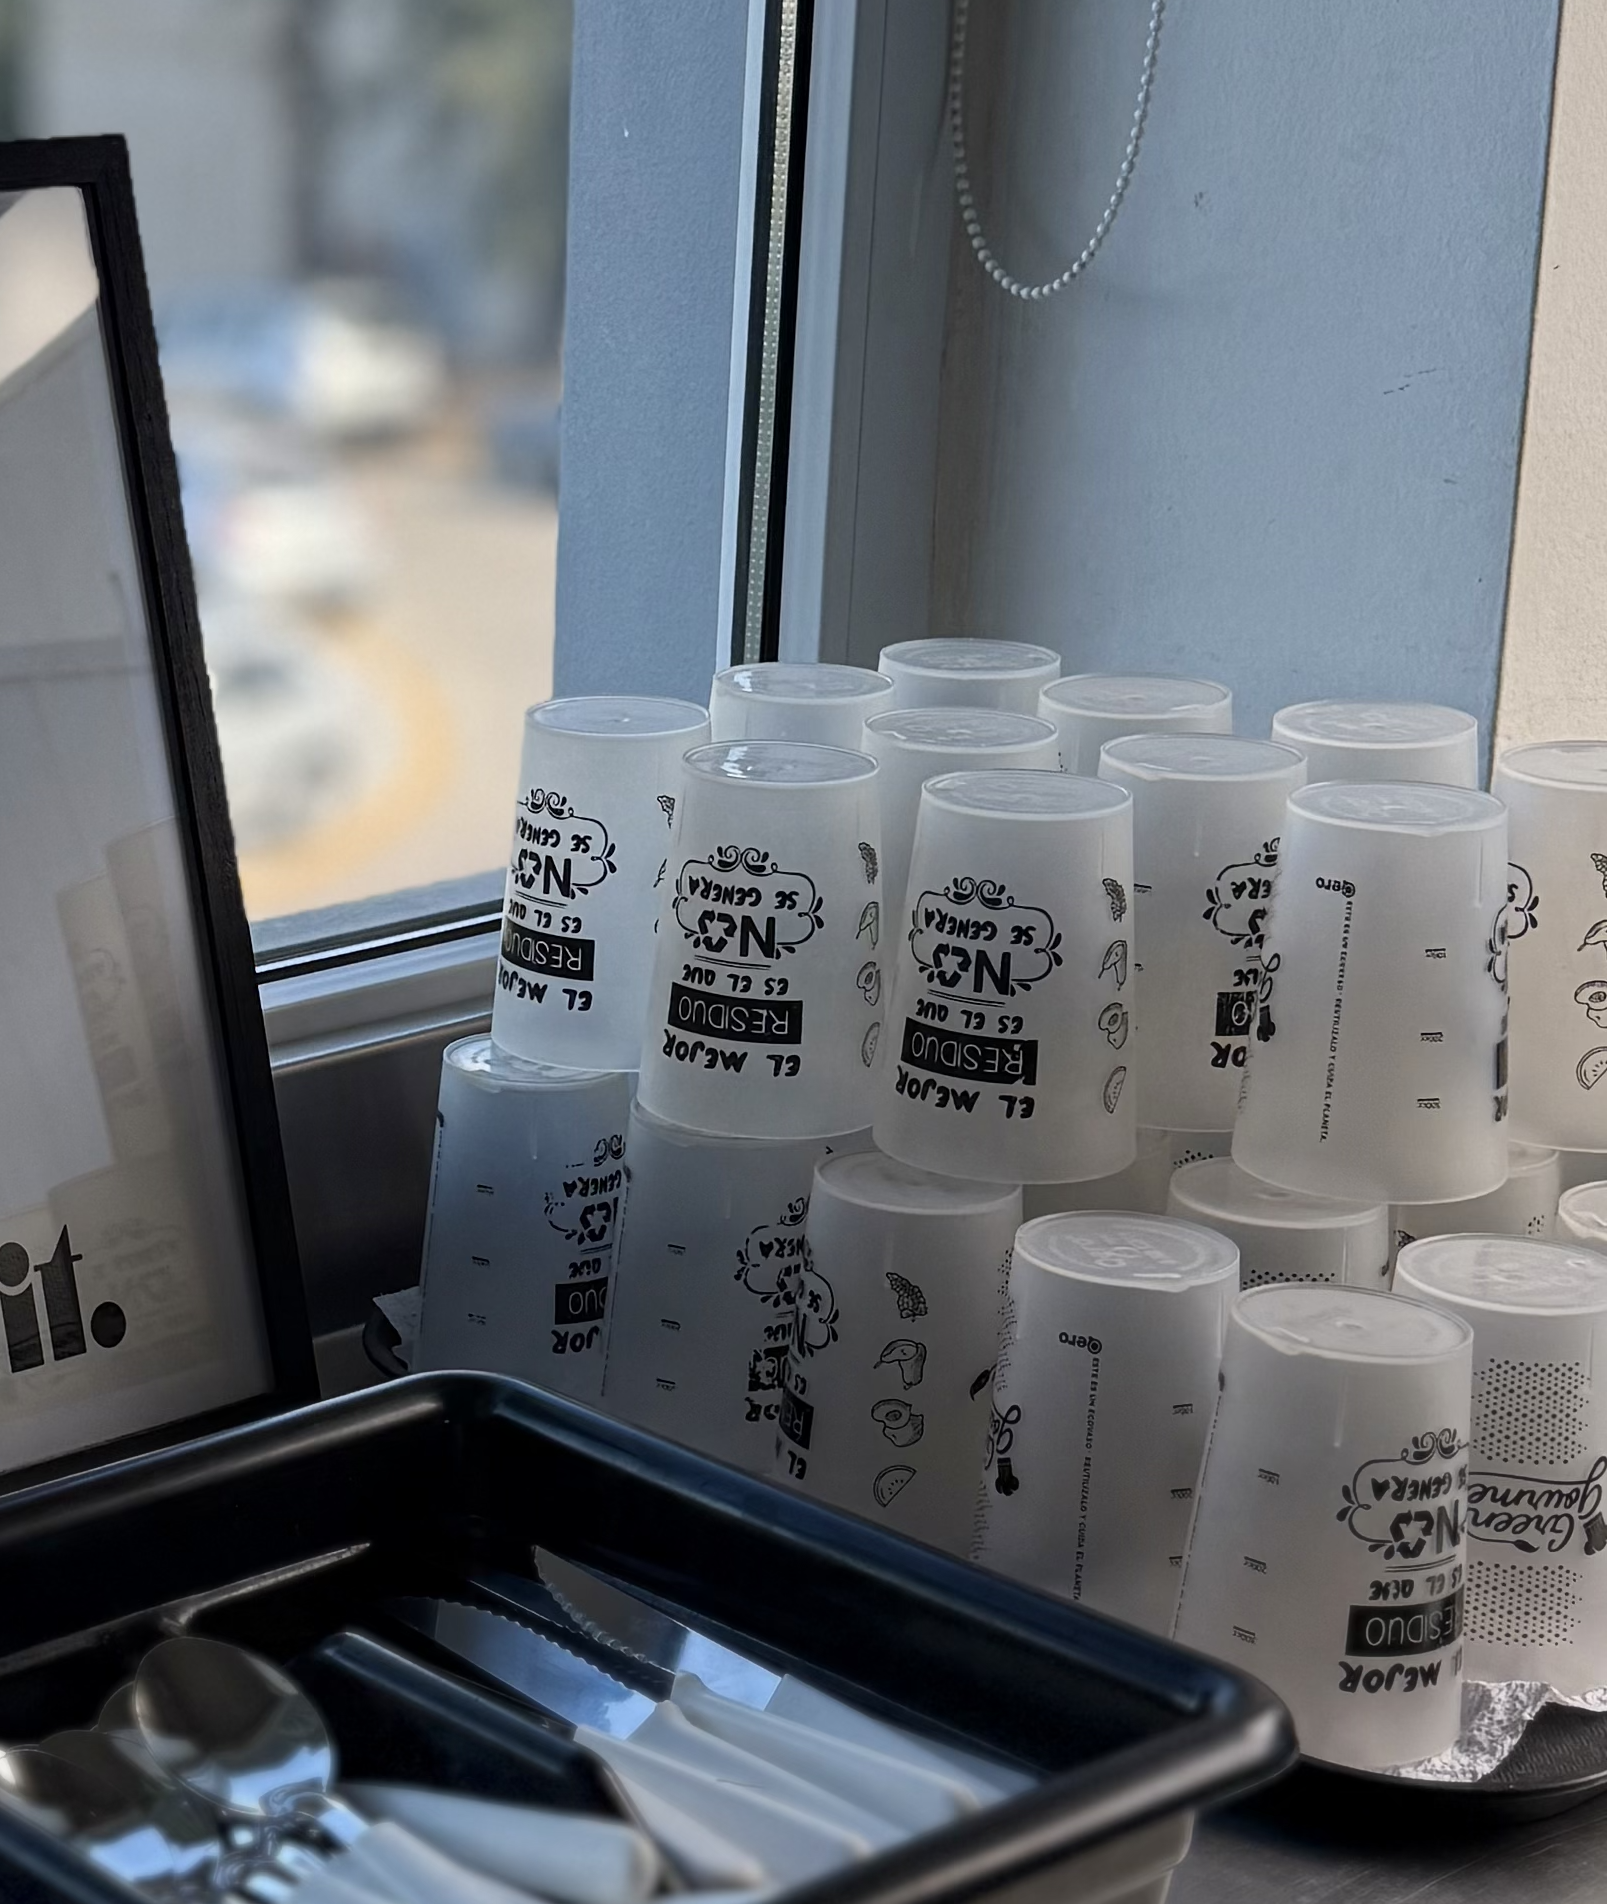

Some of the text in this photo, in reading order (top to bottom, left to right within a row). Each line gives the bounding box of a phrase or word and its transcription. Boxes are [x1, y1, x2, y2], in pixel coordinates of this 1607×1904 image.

[571, 834, 592, 852] SE
[687, 875, 799, 909] SE GENERA
[533, 909, 552, 927] EL
[561, 916, 582, 933] ES
[924, 908, 1036, 945] SE GENERA
[497, 958, 593, 1011] EL MEJO
[682, 964, 789, 995] ES EL QUE
[678, 995, 789, 1035] RESIDUO
[916, 999, 1024, 1034] ES EL QUE
[662, 1029, 801, 1077] EL MEJOR
[912, 1031, 1024, 1075] RESIDUO
[895, 1066, 1035, 1119] EL MEJOR
[1372, 1471, 1452, 1503] GENERA
[1467, 1508, 1575, 1553] Green
[1338, 1660, 1441, 1694] MEJOR
